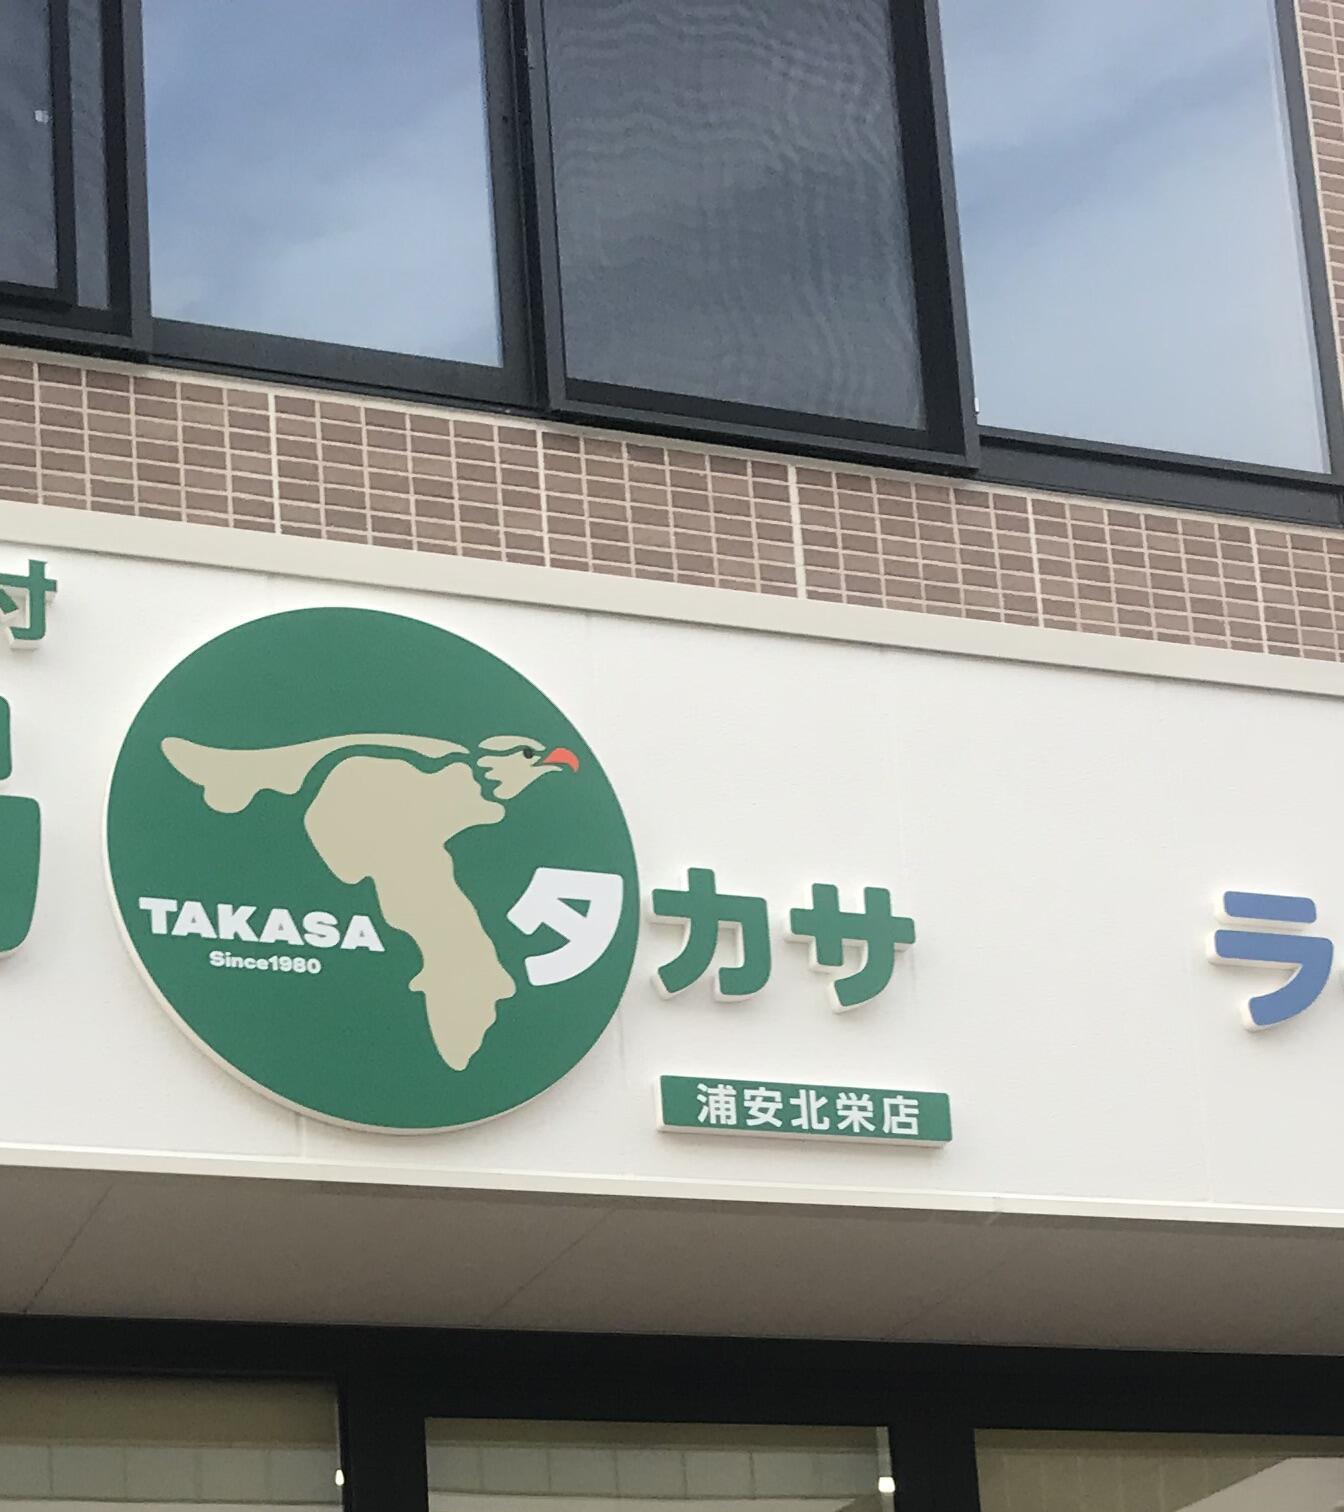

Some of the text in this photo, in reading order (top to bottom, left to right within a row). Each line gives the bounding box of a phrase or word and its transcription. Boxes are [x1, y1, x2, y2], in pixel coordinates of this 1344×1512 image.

[139, 897, 385, 952] TAKASA
[507, 867, 916, 1012] タカサ
[209, 950, 322, 974] Since1980
[695, 1084, 920, 1136] 浦安北栄店
